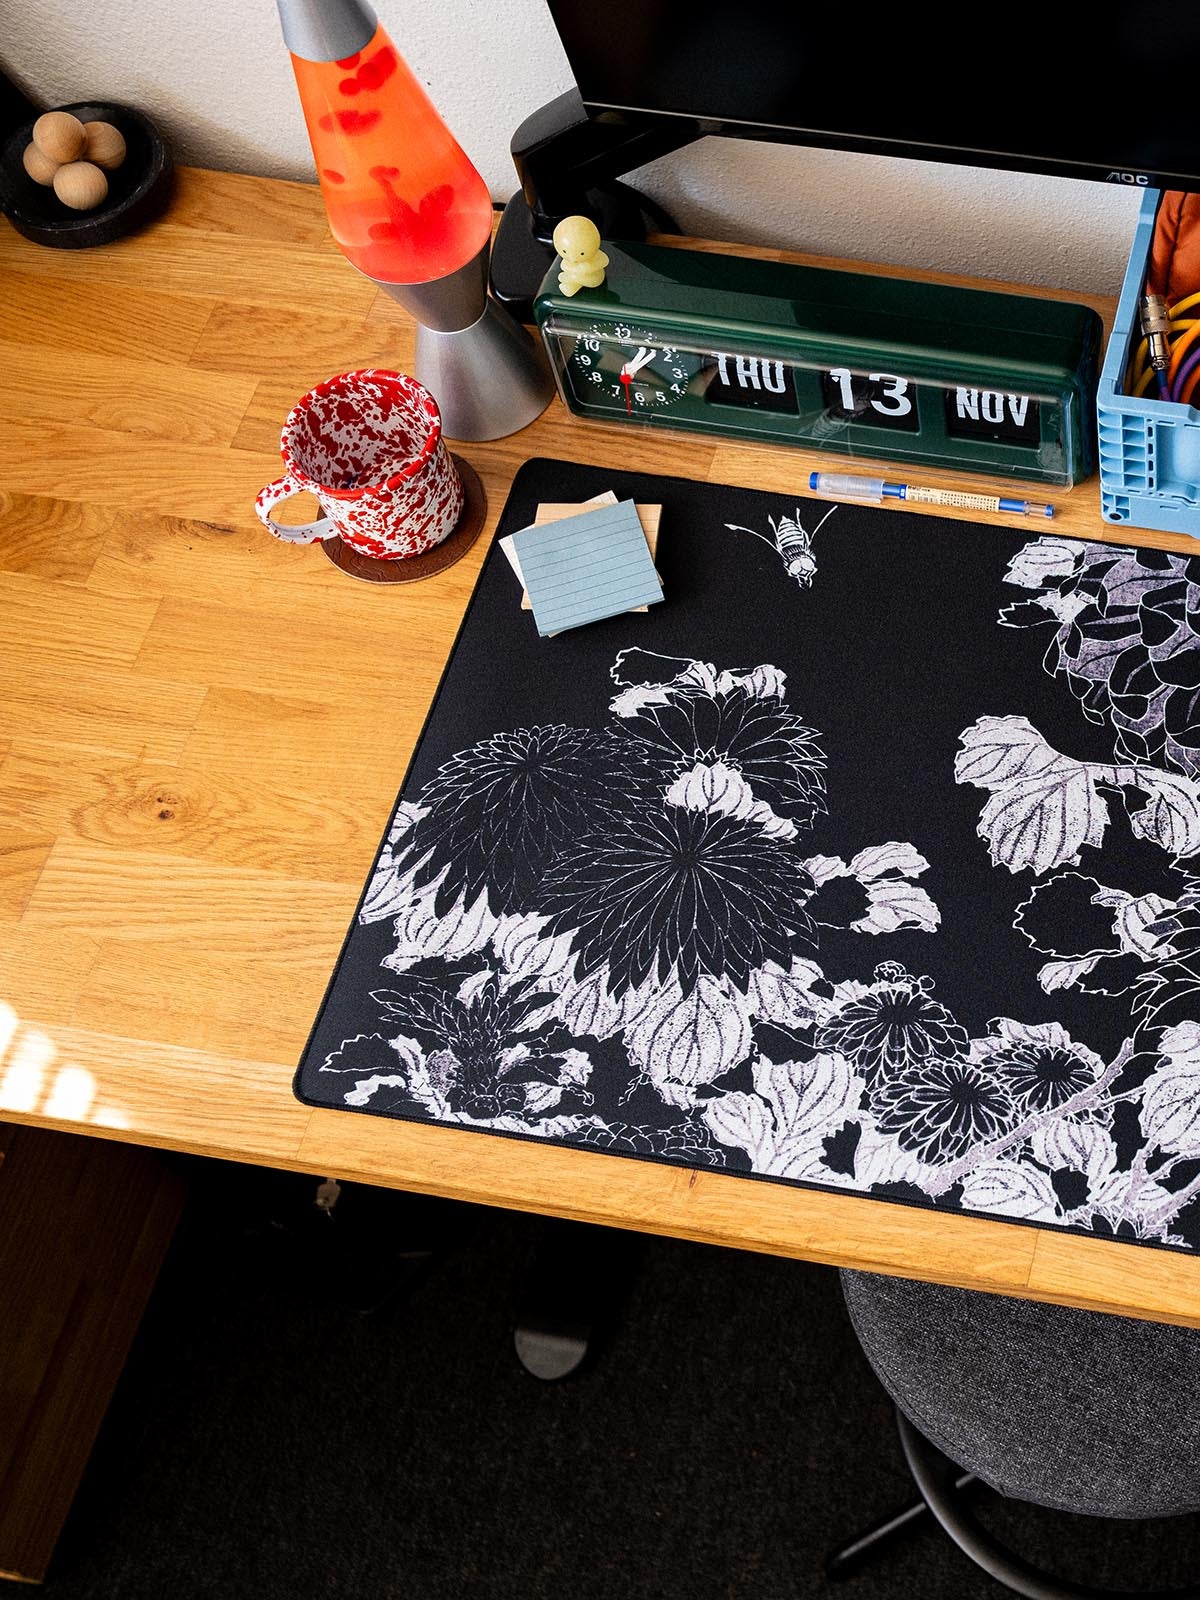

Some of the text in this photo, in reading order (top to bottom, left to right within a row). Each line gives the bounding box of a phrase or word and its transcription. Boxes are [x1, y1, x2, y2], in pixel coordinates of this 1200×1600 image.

[1106, 171, 1149, 185] AOC
[580, 354, 592, 366] 9
[591, 371, 603, 383] 8
[671, 367, 683, 379] 3
[611, 384, 621, 396] 7
[670, 383, 681, 394] 4
[711, 351, 1029, 427] THU 13 NOV
[634, 391, 645, 403] 6
[655, 391, 666, 402] 5
